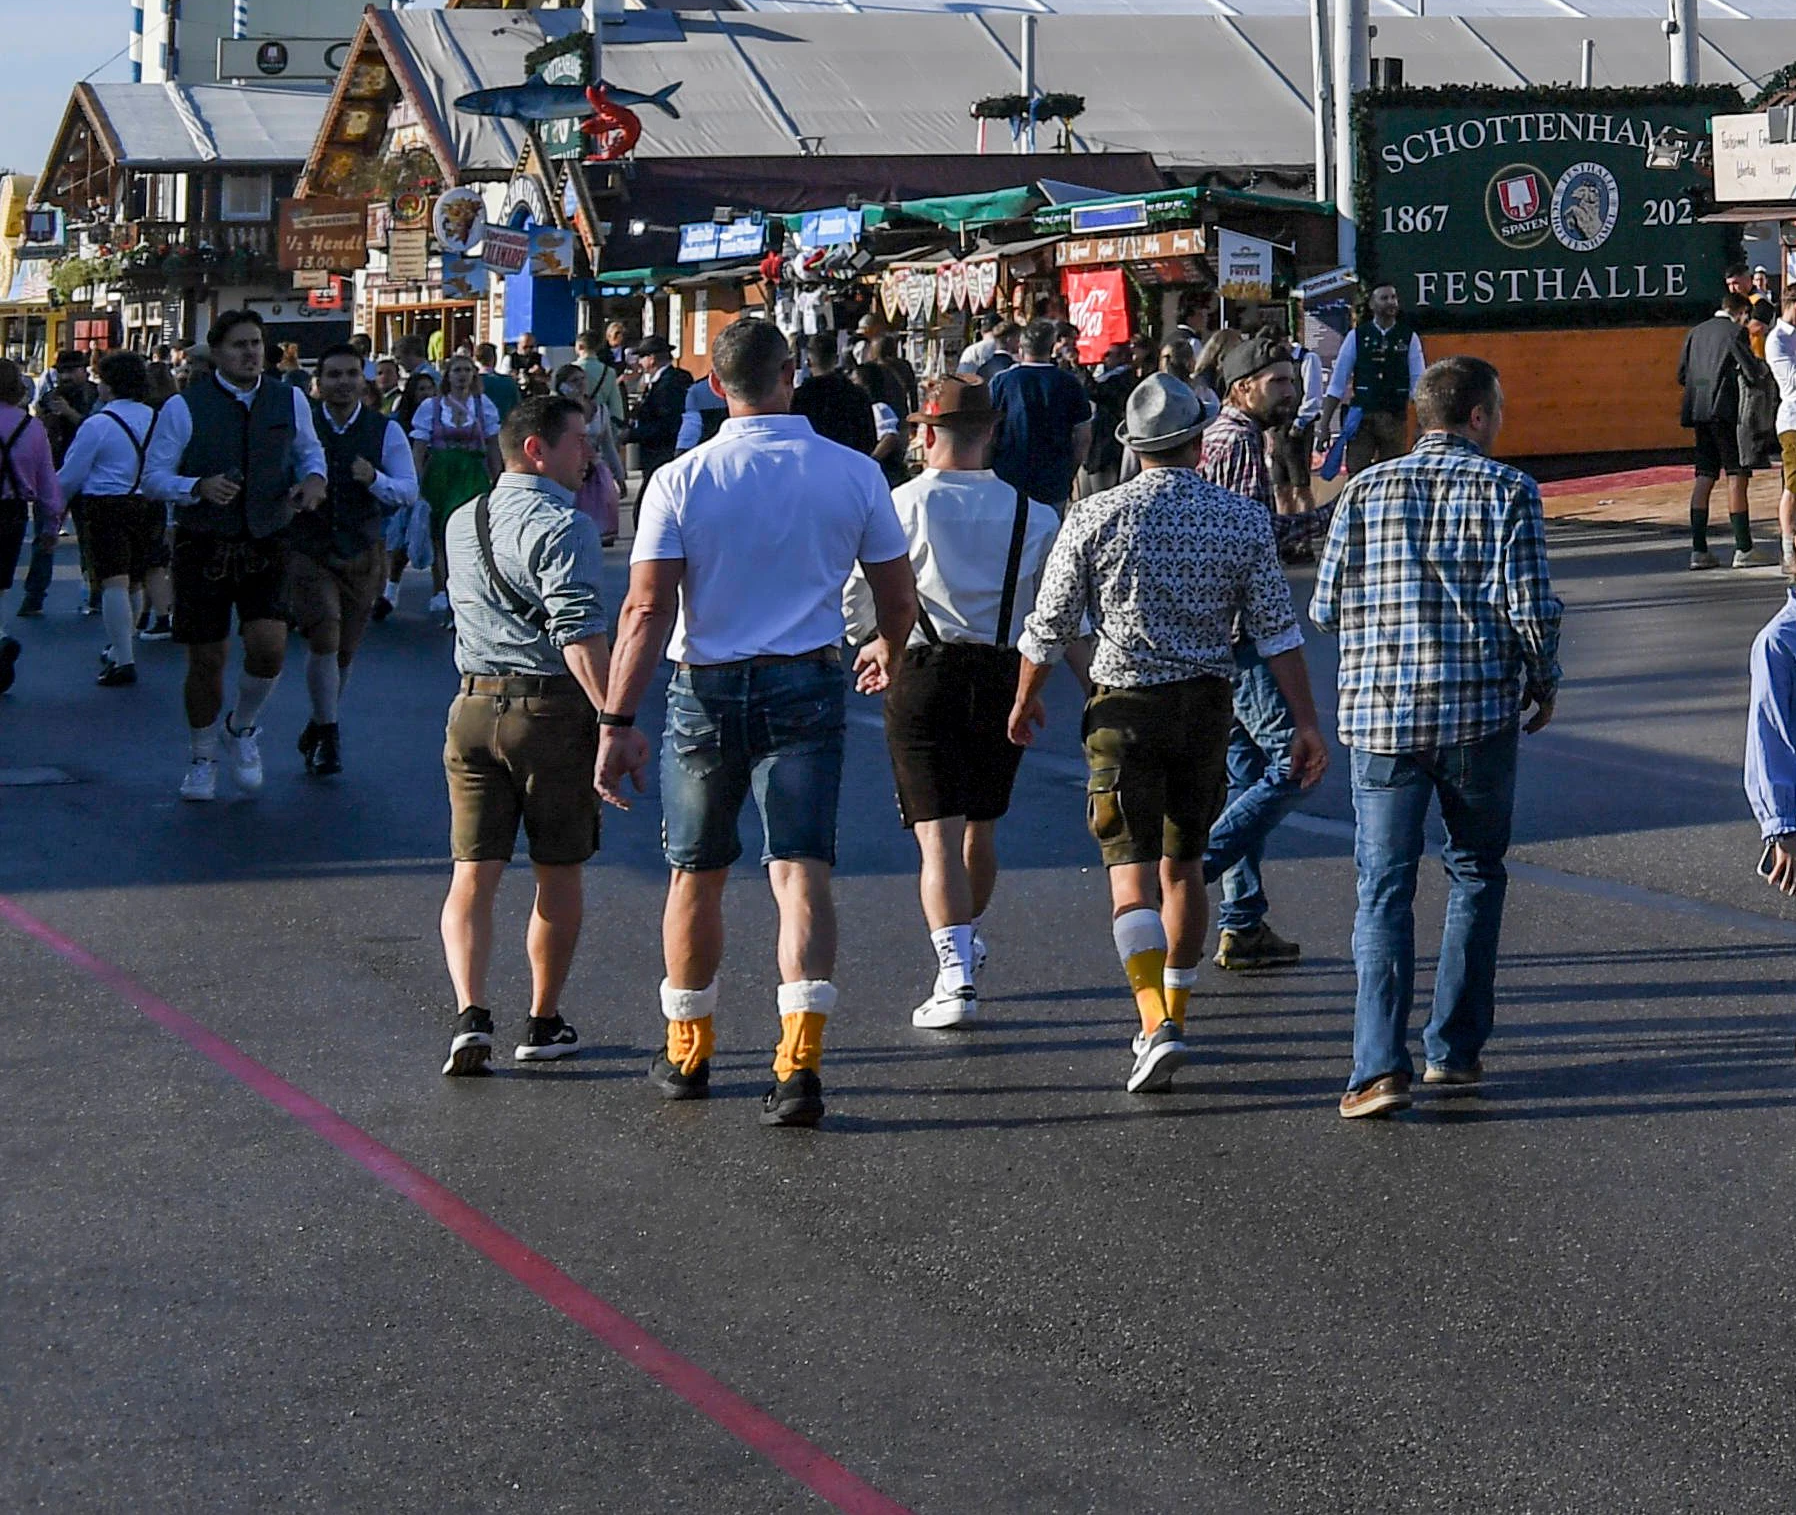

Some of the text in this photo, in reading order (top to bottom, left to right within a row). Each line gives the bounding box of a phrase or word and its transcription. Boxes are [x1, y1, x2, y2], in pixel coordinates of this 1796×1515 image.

[1382, 112, 1705, 174] SCHOTTENHA
[1382, 204, 1450, 234] 1867
[1501, 216, 1550, 237] SPATEN
[1642, 198, 1693, 226] 202
[1413, 264, 1689, 307] FESTHALLE
